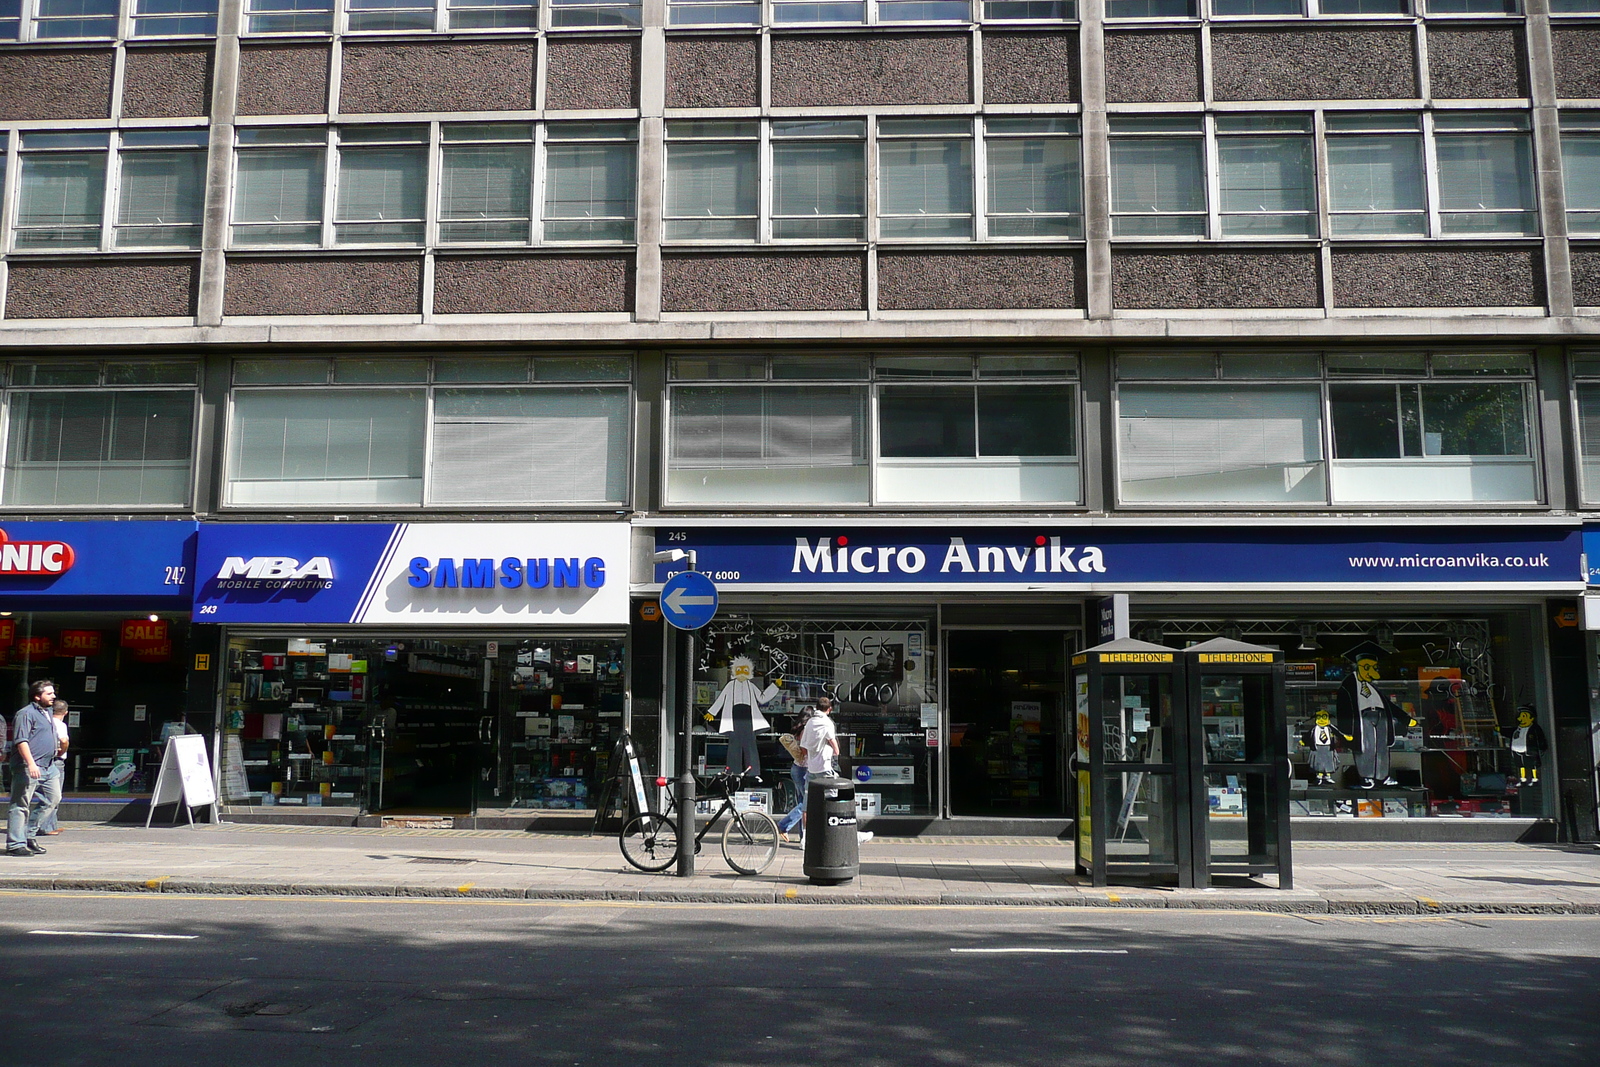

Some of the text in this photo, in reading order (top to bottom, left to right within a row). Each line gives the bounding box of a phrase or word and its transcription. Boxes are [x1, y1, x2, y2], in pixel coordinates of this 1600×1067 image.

[668, 532, 687, 541] 245
[0, 543, 64, 572] NIC
[791, 535, 1107, 574] Micro Anvika
[1348, 553, 1549, 568] www.microanvika.co.uk
[216, 556, 334, 579] MBA
[408, 556, 606, 589] SAMSUNG
[164, 566, 187, 585] 242
[715, 571, 740, 580] 6000
[217, 580, 333, 589] MOBILE COMPUTING
[199, 605, 218, 614] 243
[125, 626, 166, 640] SALE
[19, 642, 51, 655] SALE
[63, 636, 98, 649] SALE
[821, 636, 895, 660] BACK
[1106, 653, 1167, 662] TELEPHONE
[1206, 653, 1267, 662] TELEPHONE
[883, 804, 911, 812] ASUS
